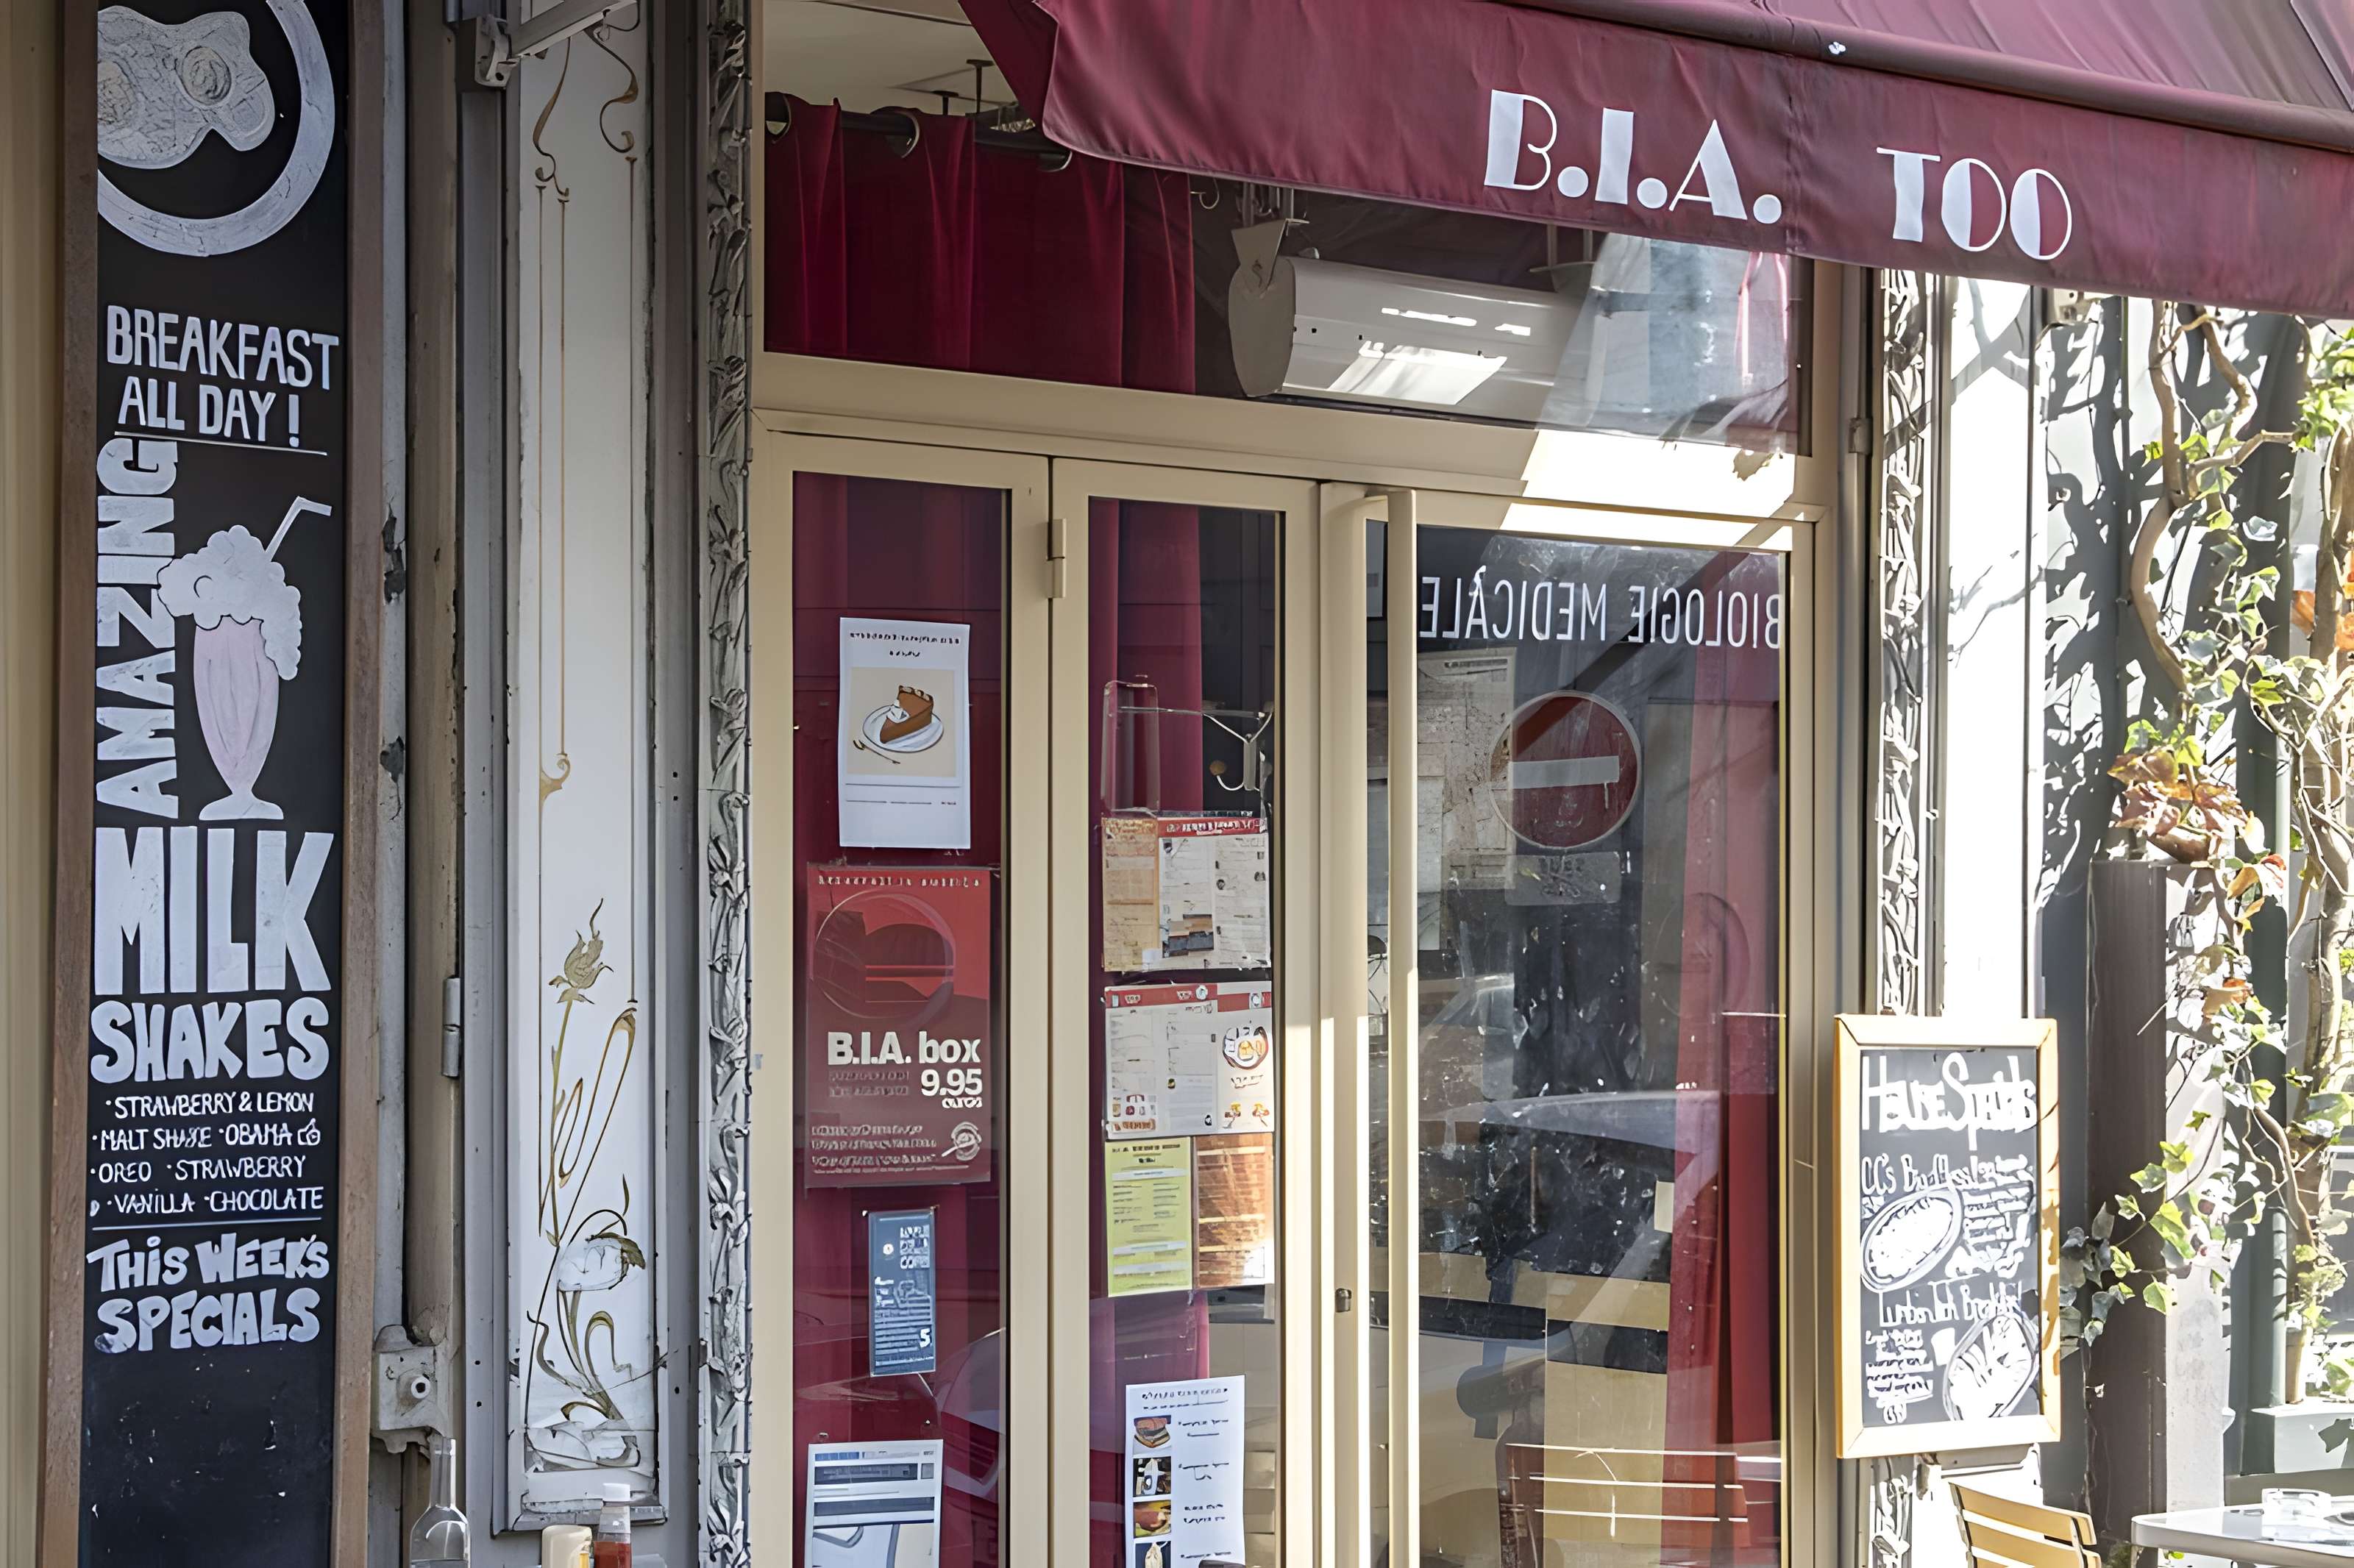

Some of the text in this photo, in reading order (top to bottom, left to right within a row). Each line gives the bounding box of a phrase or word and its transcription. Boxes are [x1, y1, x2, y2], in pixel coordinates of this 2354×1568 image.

[1484, 89, 2072, 261] B.I.A. TOO
[107, 305, 338, 390] BREAKFAST
[118, 376, 185, 430] ALL
[96, 438, 179, 819] AMAZING
[94, 826, 334, 995] MILK
[90, 997, 330, 1083] SHAKES
[828, 1030, 981, 1065] B.I.A. box
[115, 1091, 314, 1119] STRAWBERRY & LEMON
[921, 1068, 983, 1097] 9.95
[101, 1128, 149, 1151] MALT
[225, 1122, 293, 1146] OBAMA
[99, 1155, 306, 1183] OREO STRAWBERRY
[210, 1186, 324, 1212] CHOCOLATE
[94, 1288, 321, 1353] SPECIALS
